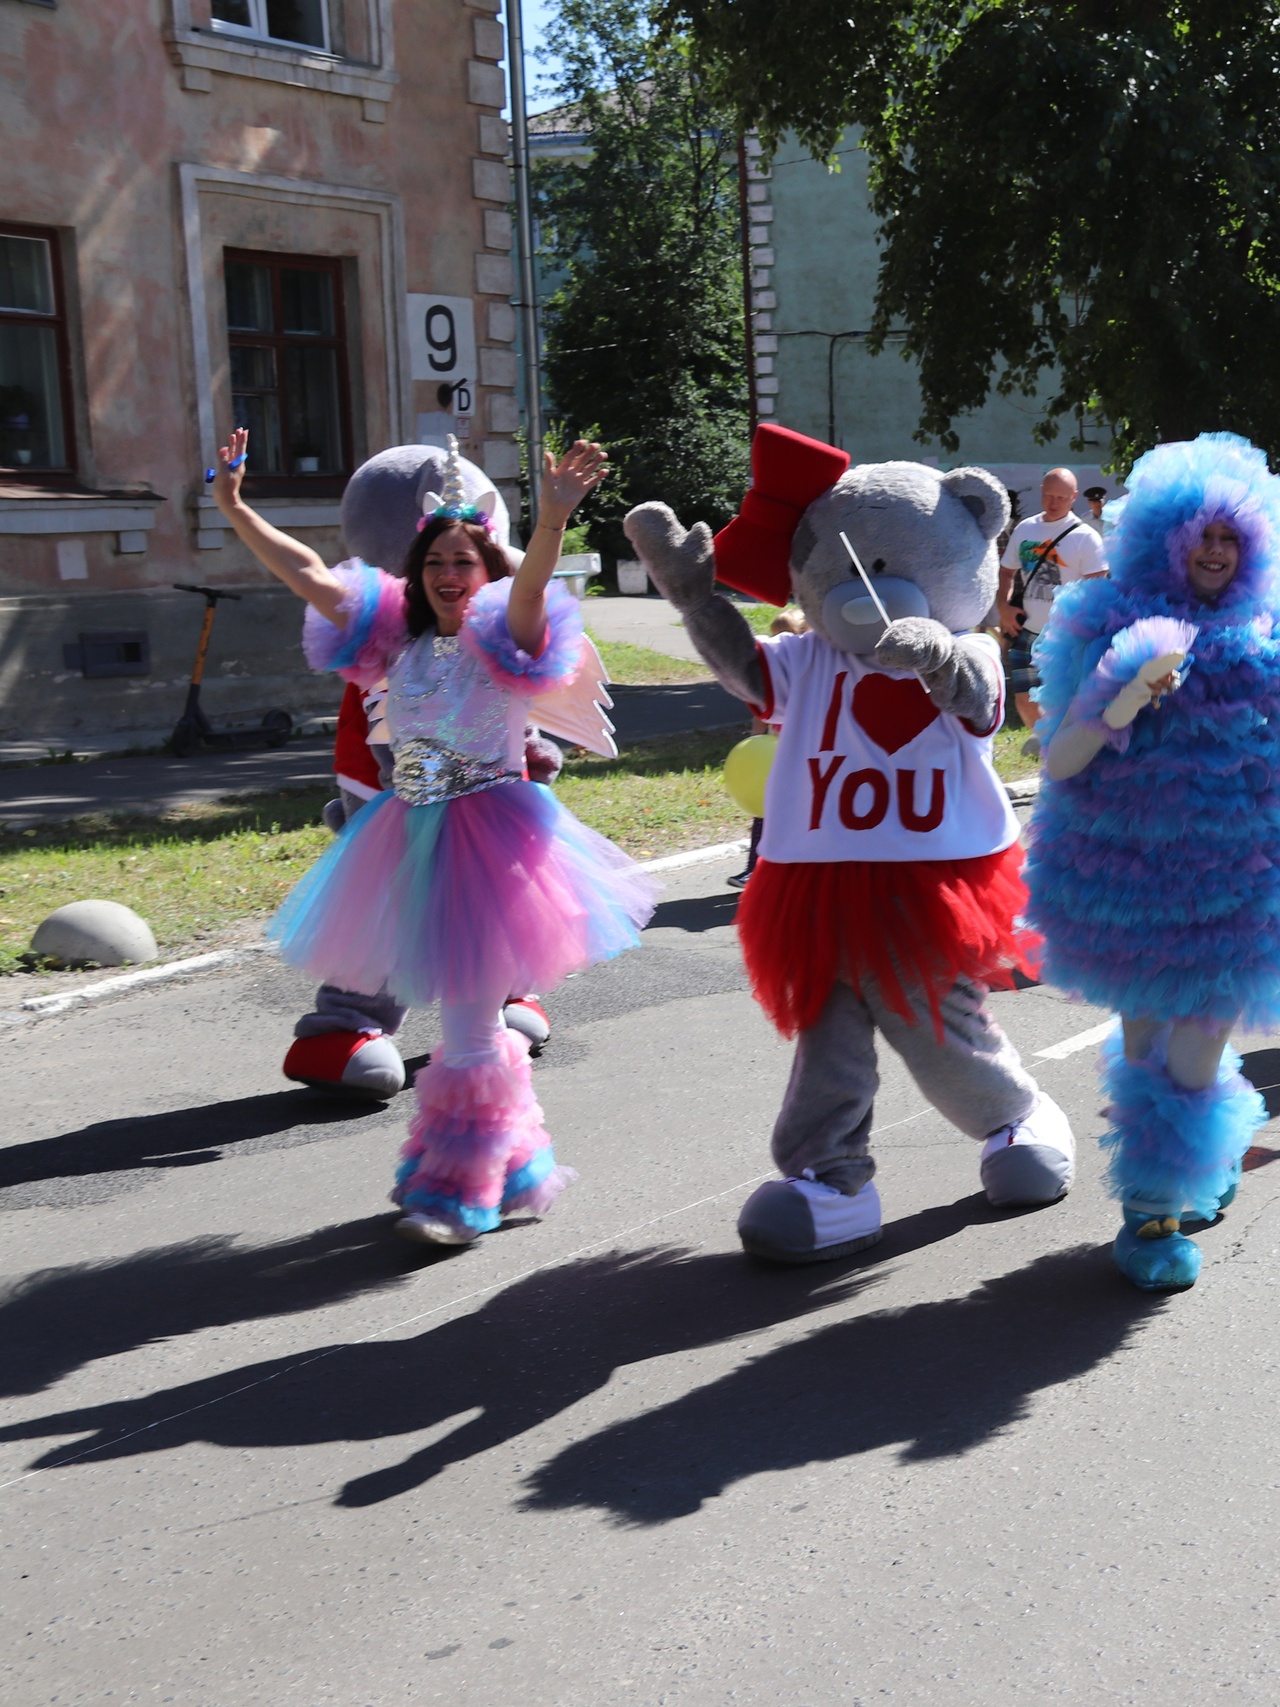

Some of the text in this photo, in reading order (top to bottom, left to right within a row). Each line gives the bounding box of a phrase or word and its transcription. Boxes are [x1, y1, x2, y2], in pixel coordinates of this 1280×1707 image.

[425, 304, 457, 372] 9
[818, 671, 849, 753] I
[807, 755, 946, 833] YOU
